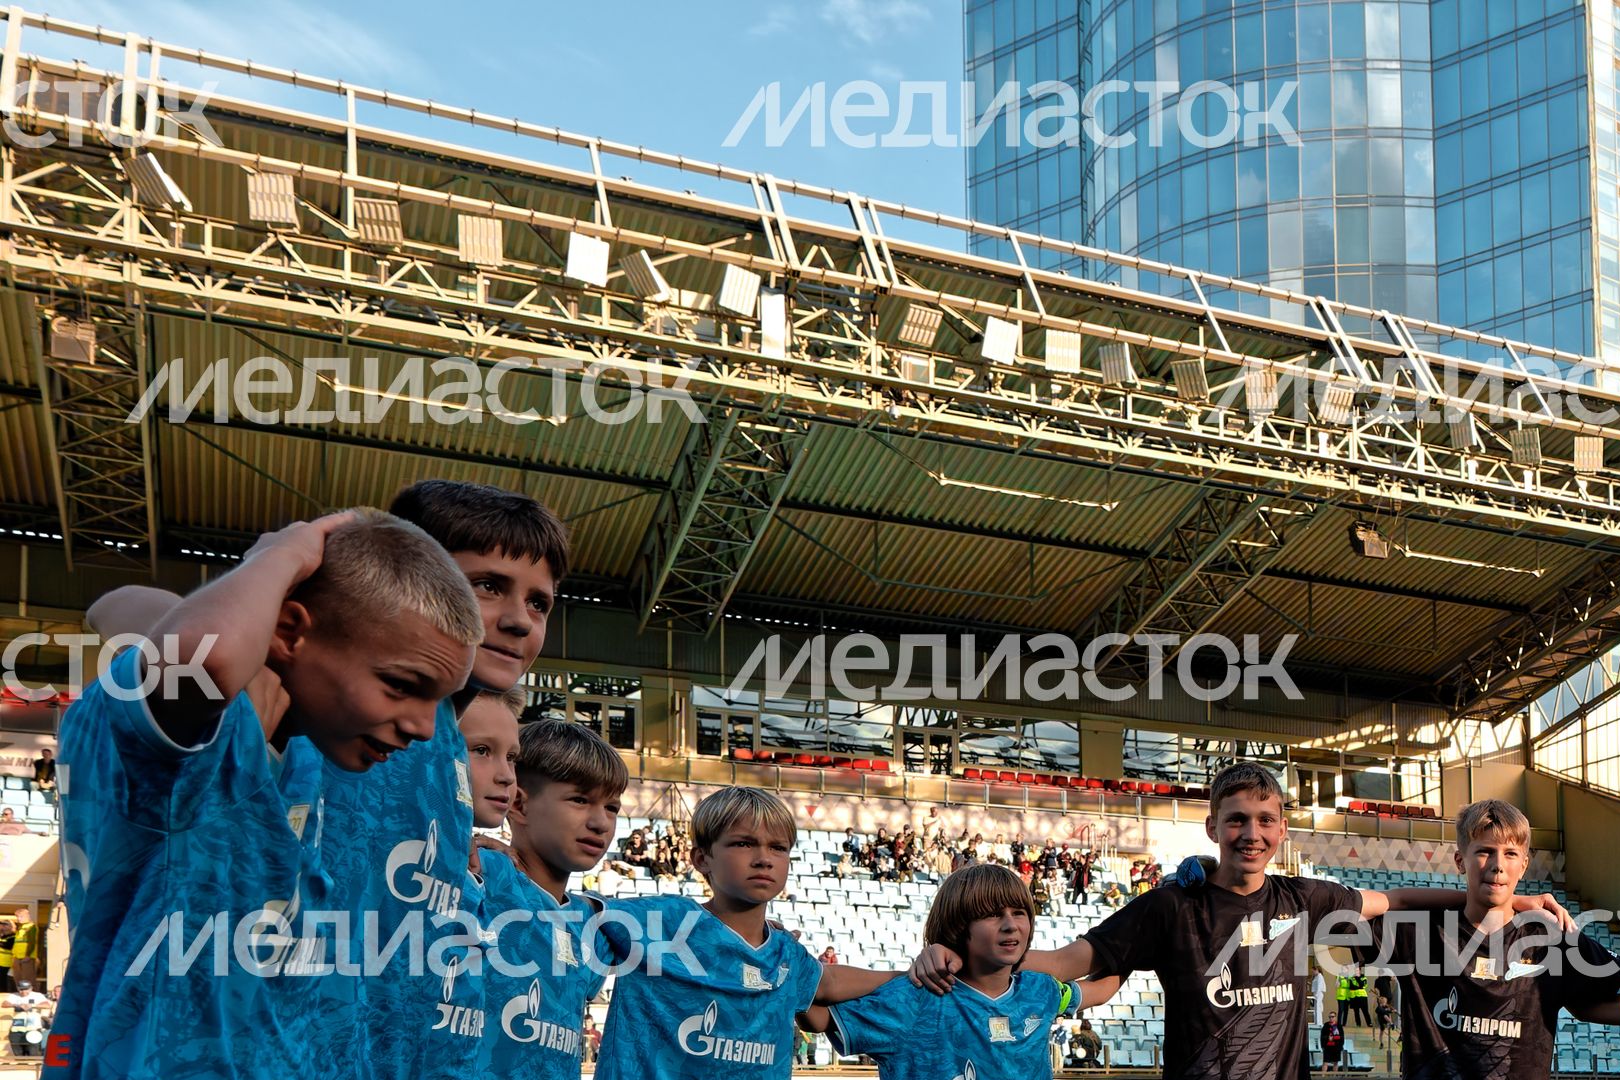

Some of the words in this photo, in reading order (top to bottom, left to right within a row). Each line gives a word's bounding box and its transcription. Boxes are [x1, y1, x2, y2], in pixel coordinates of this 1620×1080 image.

[1235, 983, 1294, 1007] ГАЗПРОМ
[1457, 1015, 1522, 1039] ГАЗПРОМ
[713, 1037, 776, 1066] ГАЗПРОМ
